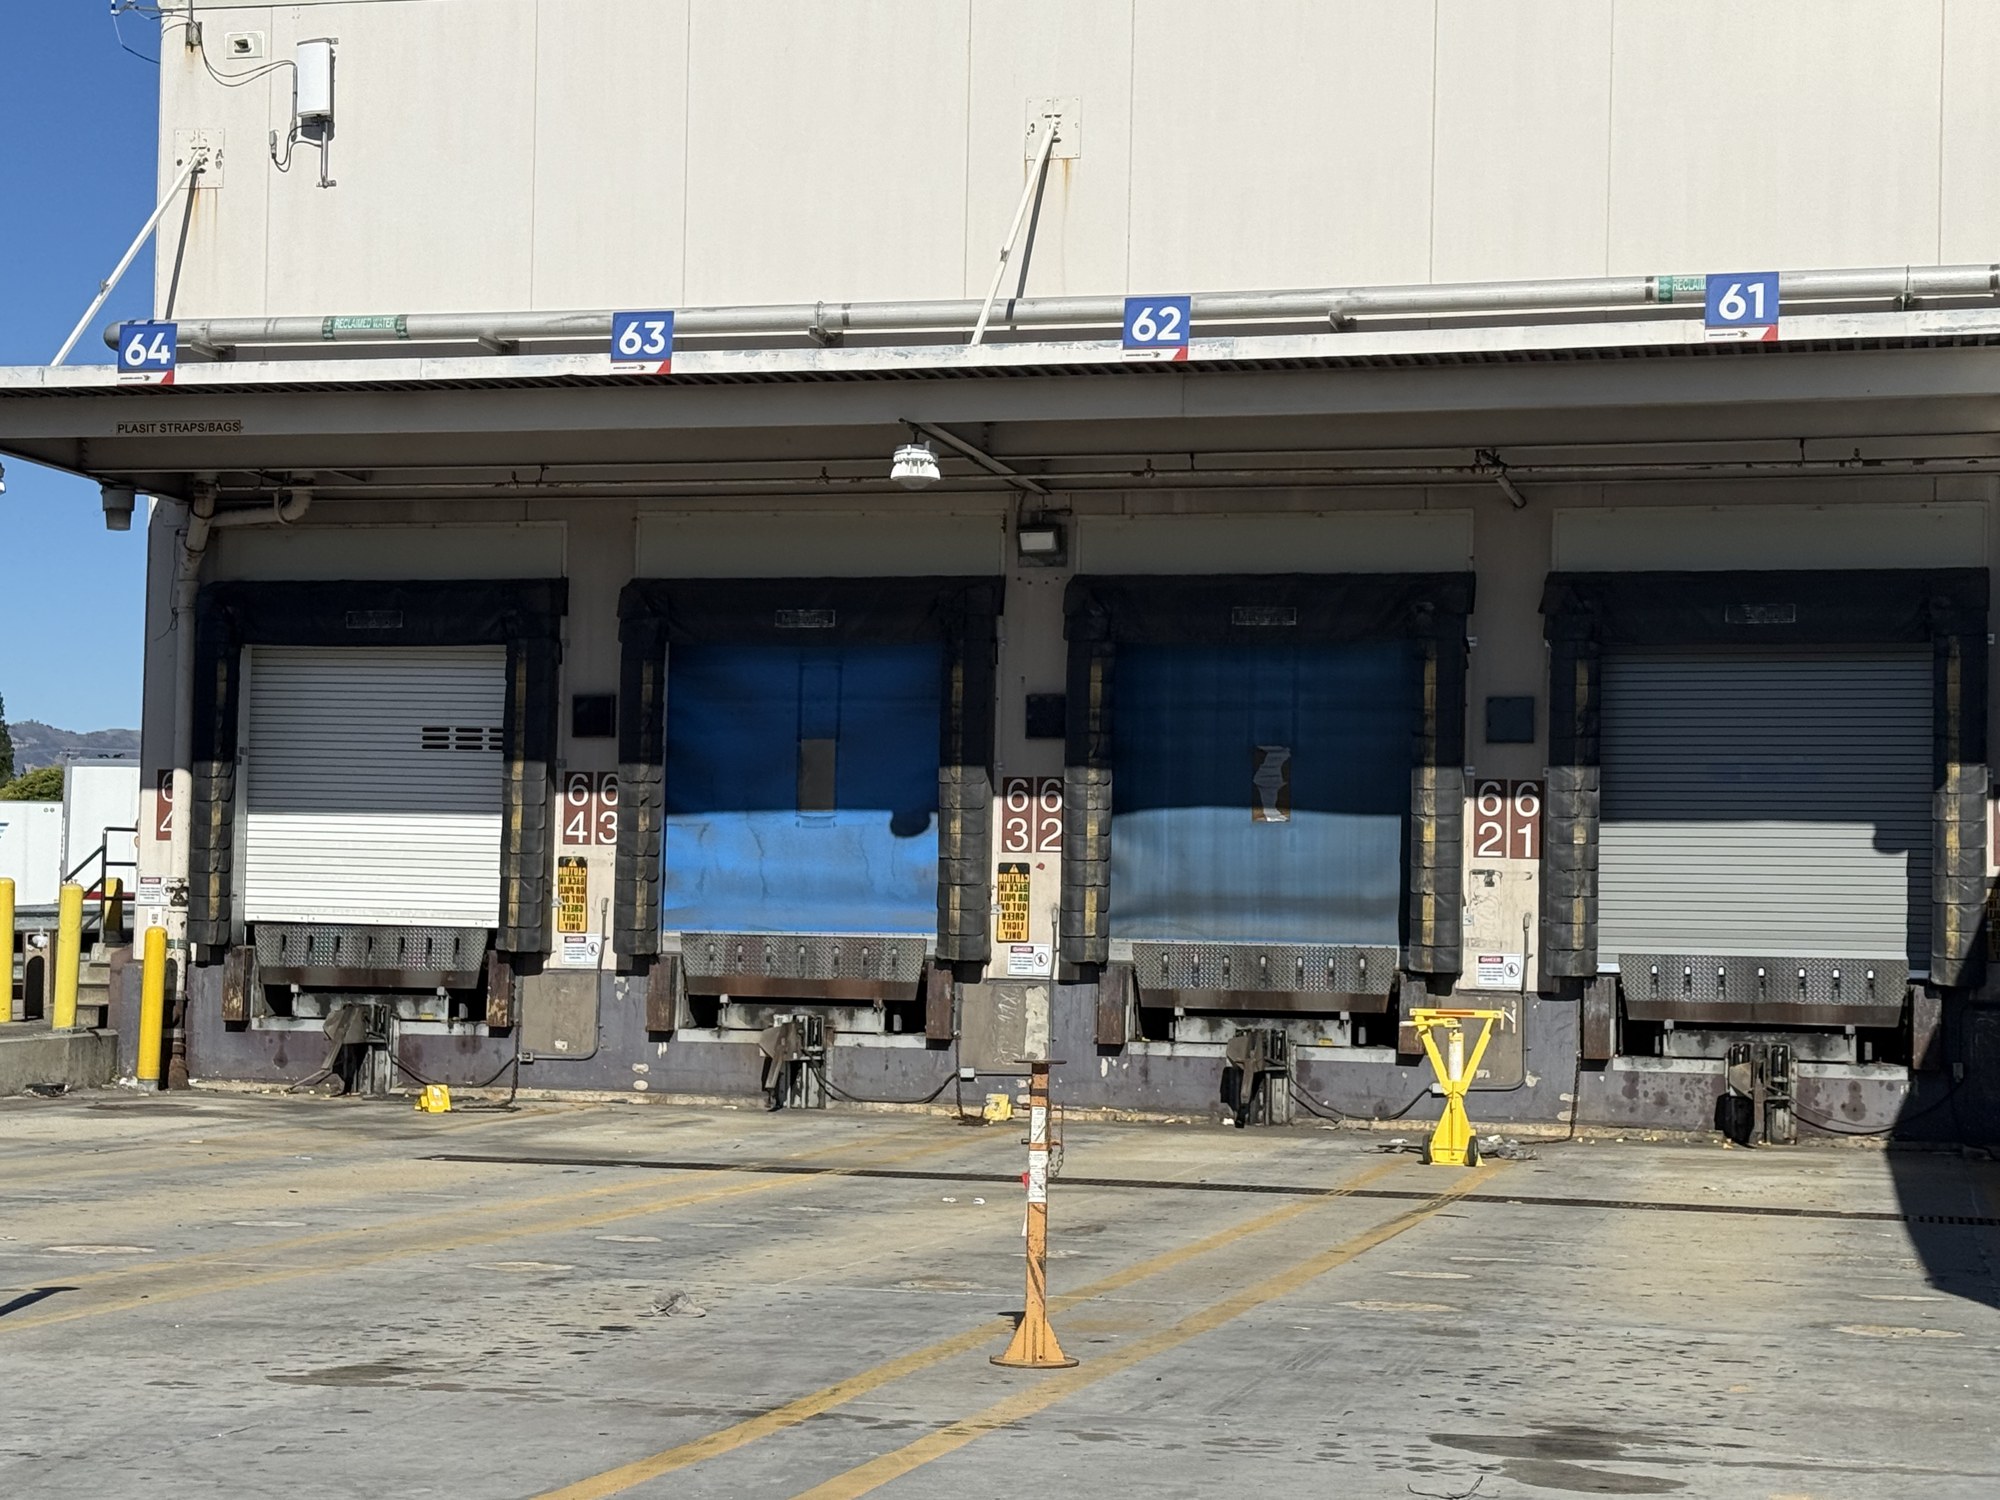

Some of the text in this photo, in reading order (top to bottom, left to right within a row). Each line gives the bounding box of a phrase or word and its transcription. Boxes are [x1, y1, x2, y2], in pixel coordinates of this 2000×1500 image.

[1718, 282, 1764, 320] 61
[334, 317, 395, 329] RECLAIMED WATER
[619, 321, 665, 355] 63
[1131, 306, 1181, 342] 62
[125, 332, 171, 366] 64
[117, 422, 240, 434] PLASIT STRAPS/BAGS
